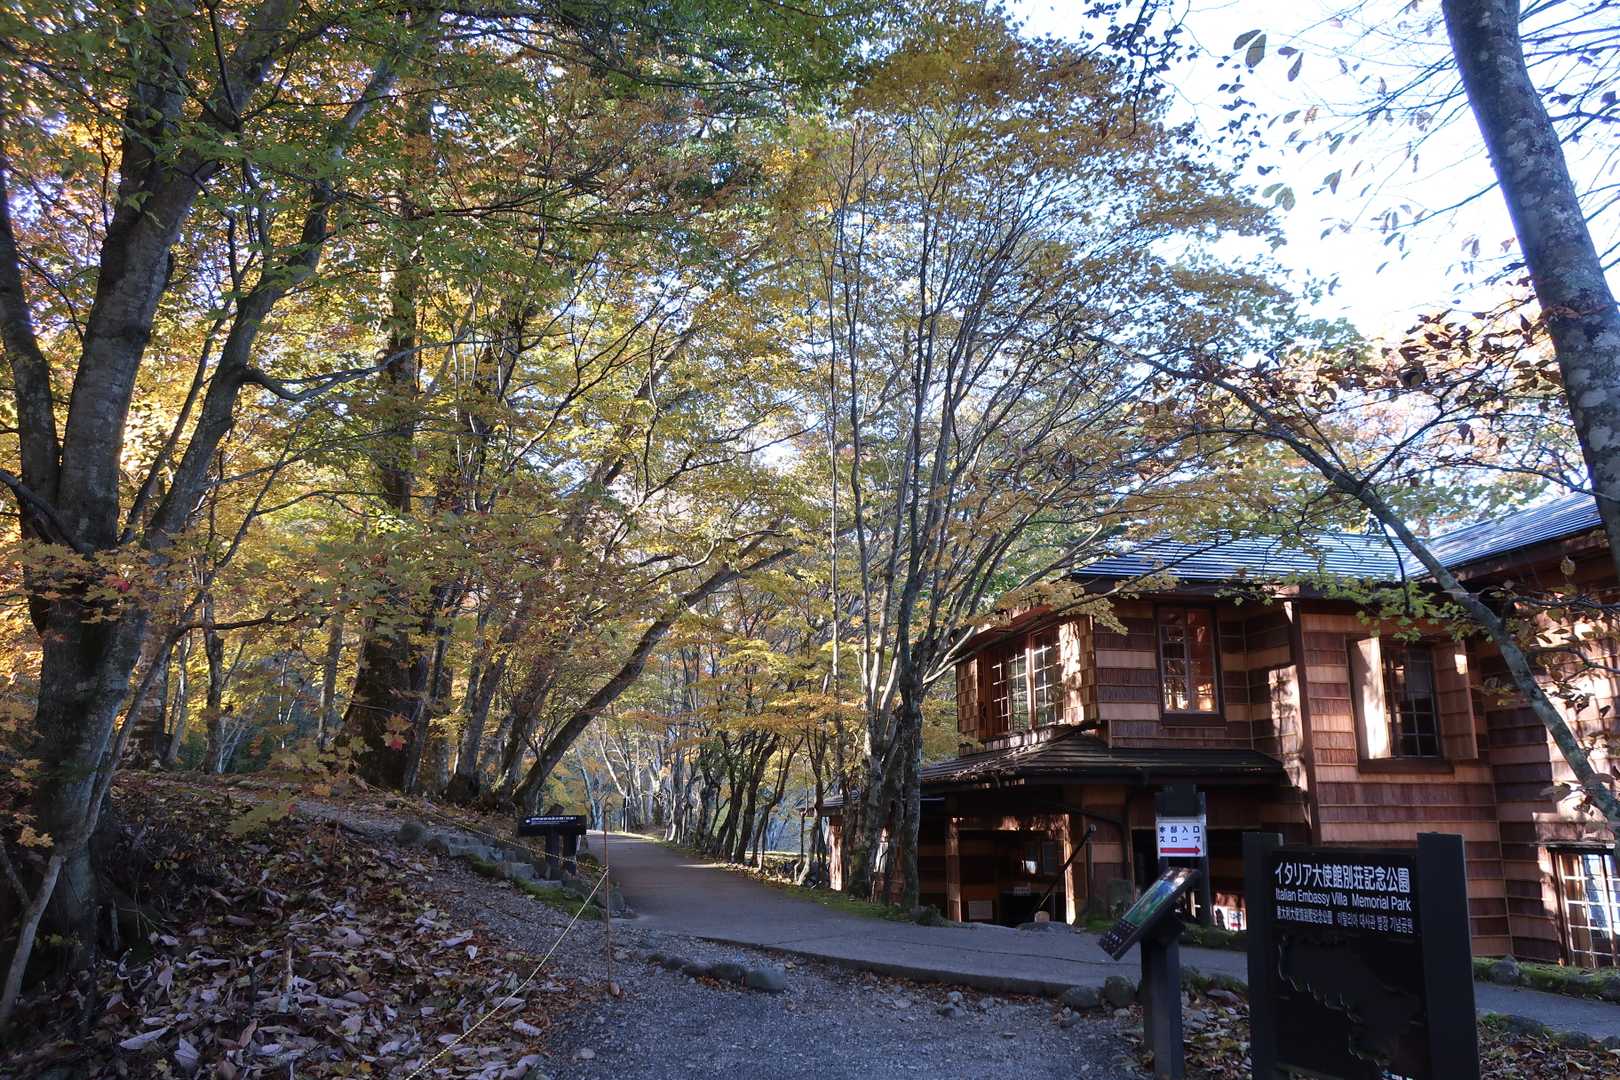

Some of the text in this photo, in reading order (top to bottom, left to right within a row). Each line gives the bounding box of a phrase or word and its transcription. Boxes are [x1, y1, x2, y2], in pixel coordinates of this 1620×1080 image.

[1274, 861, 1411, 894] イタリア大使館別荘記念公園
[1275, 887, 1412, 912] Italian Embassy Villa Memorial Park
